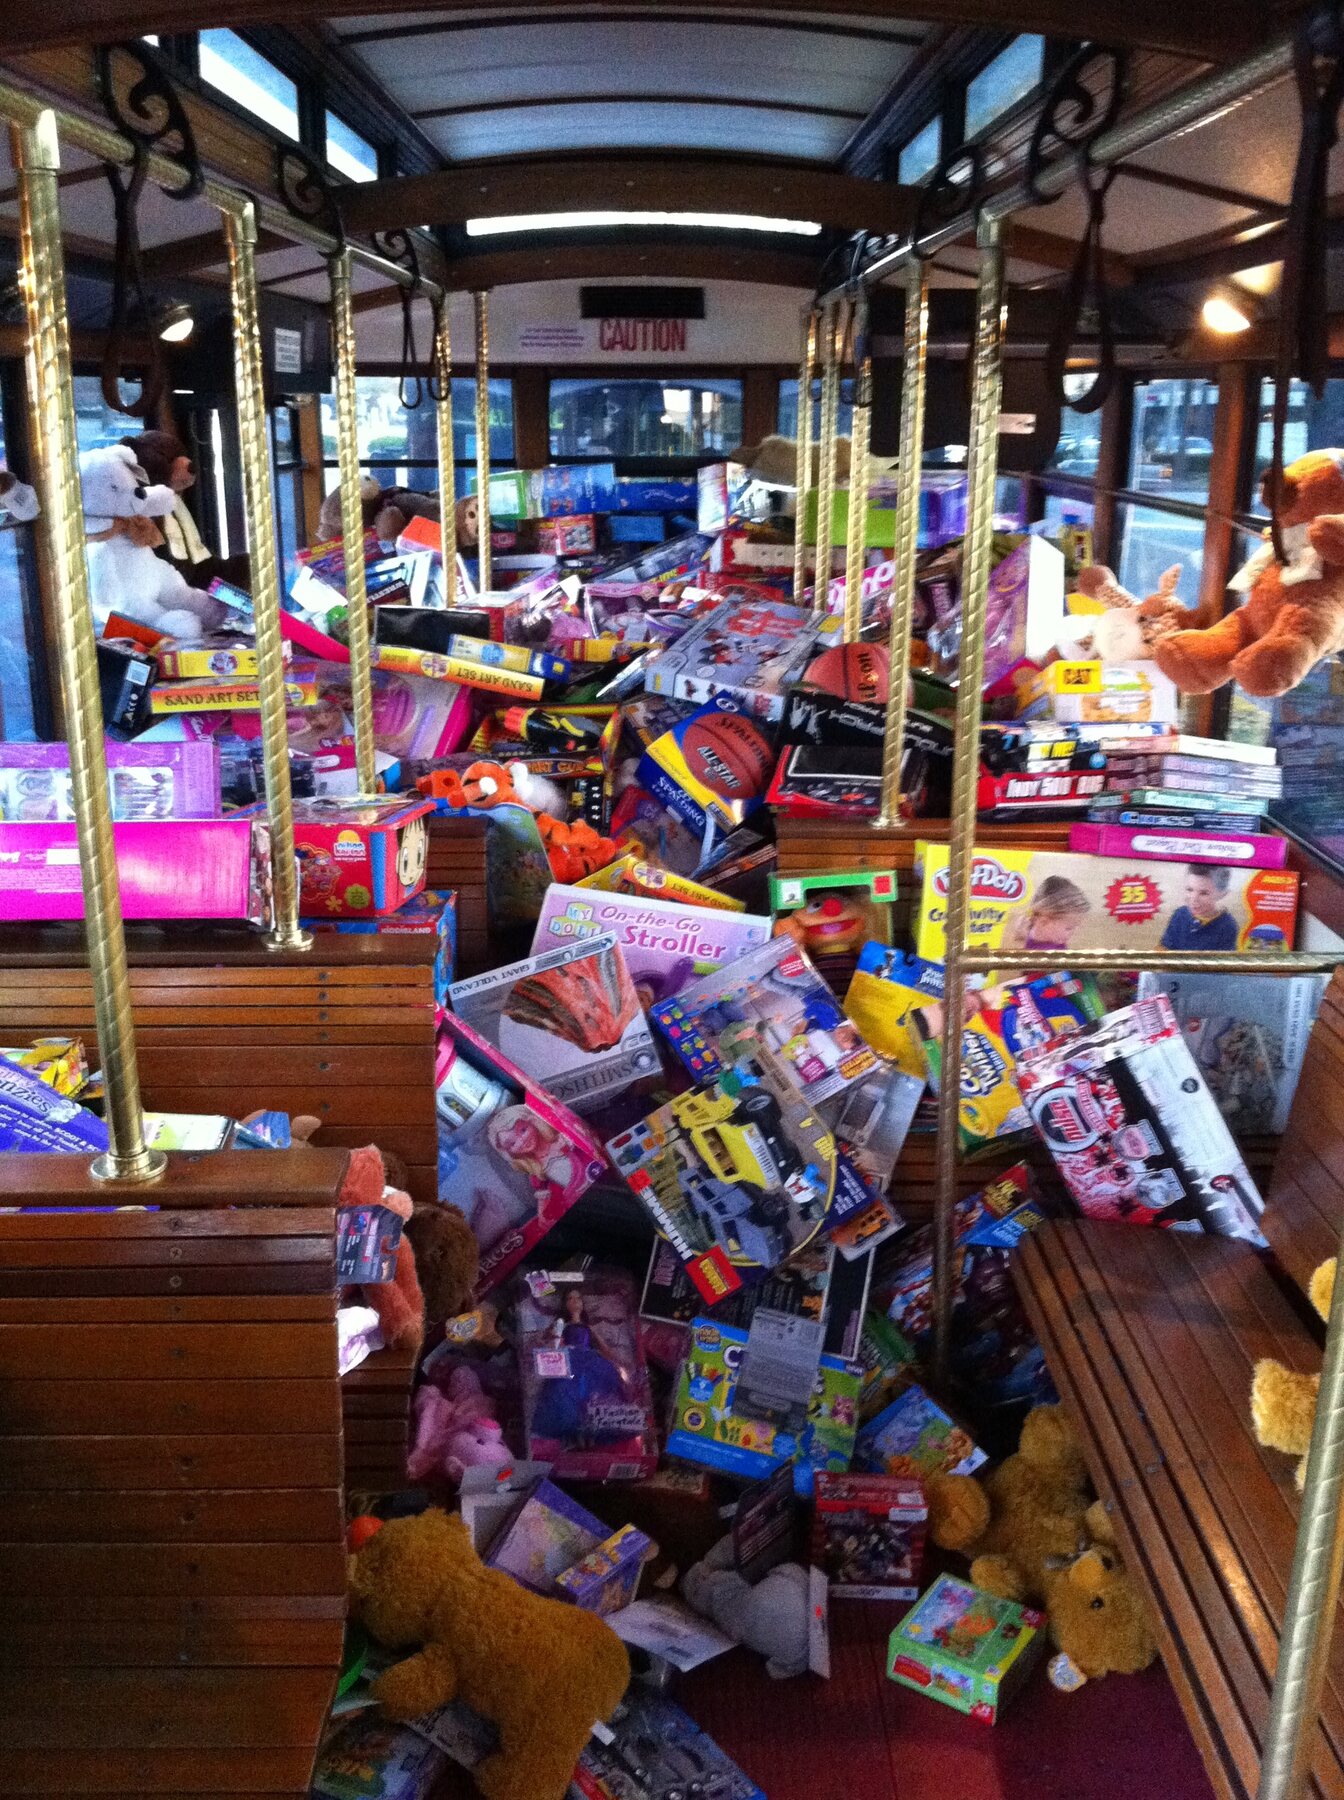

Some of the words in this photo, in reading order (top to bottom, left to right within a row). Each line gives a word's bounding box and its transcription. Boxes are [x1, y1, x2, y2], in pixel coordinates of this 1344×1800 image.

[600, 319, 686, 351] CAUTION
[456, 667, 477, 680] SET
[480, 672, 501, 685] ART
[501, 677, 534, 692] SAND
[164, 692, 205, 707] SAND
[206, 692, 233, 704] ART
[828, 709, 885, 737] PACK
[657, 776, 705, 827] SPALDING
[935, 864, 1020, 895] P-Doh
[1119, 886, 1148, 904] 35
[568, 907, 591, 921] MY
[600, 906, 702, 933] On-the-Go
[929, 907, 1007, 922] Crvity
[621, 925, 727, 959] Stroller
[501, 963, 530, 979] GIANT
[452, 974, 499, 995] VOLCANO
[550, 1061, 633, 1099] SMITHSO
[640, 1185, 693, 1260] HUMME
